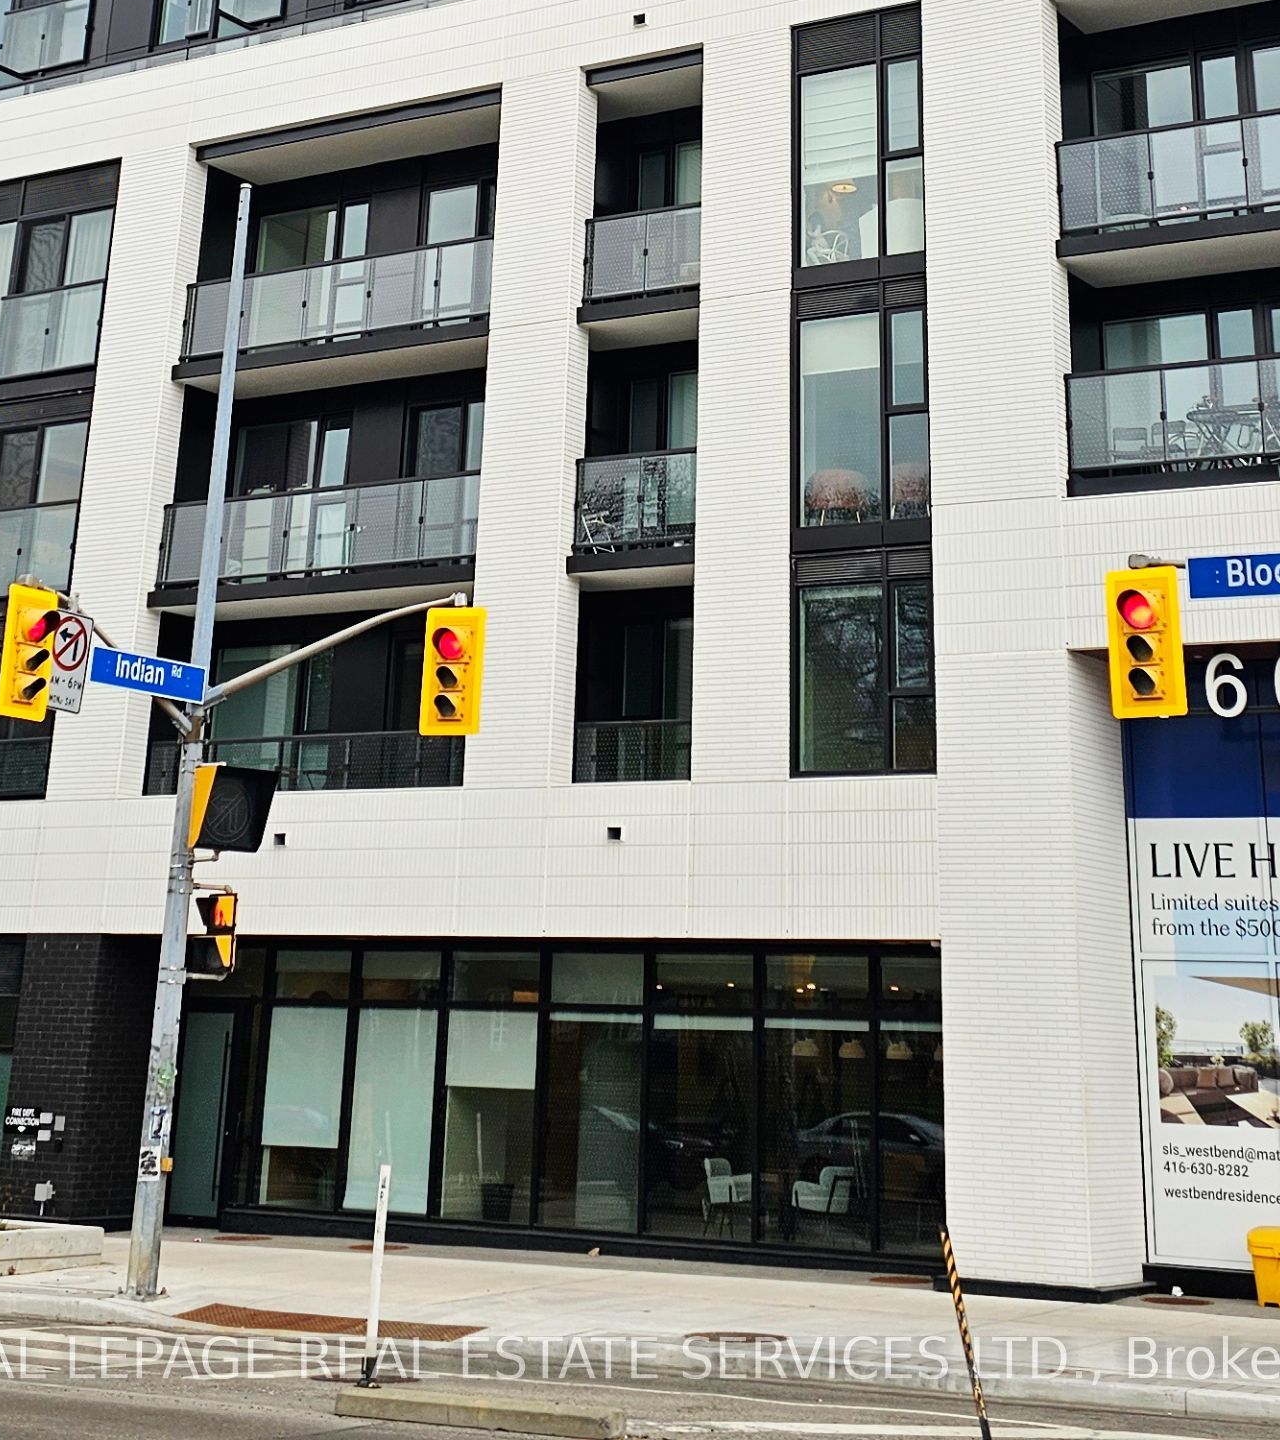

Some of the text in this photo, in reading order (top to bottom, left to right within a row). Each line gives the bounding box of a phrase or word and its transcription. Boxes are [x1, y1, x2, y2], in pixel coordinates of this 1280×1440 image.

[115, 654, 183, 686] Indian Rd
[1149, 842, 1237, 879] LIVE
[1150, 892, 1219, 912] Limited
[1224, 895, 1279, 912] suites
[1152, 918, 1195, 936] from
[1200, 918, 1230, 937] the
[5, 1116, 40, 1127] CONNECTION
[1163, 1161, 1250, 1178] 416-630-8282
